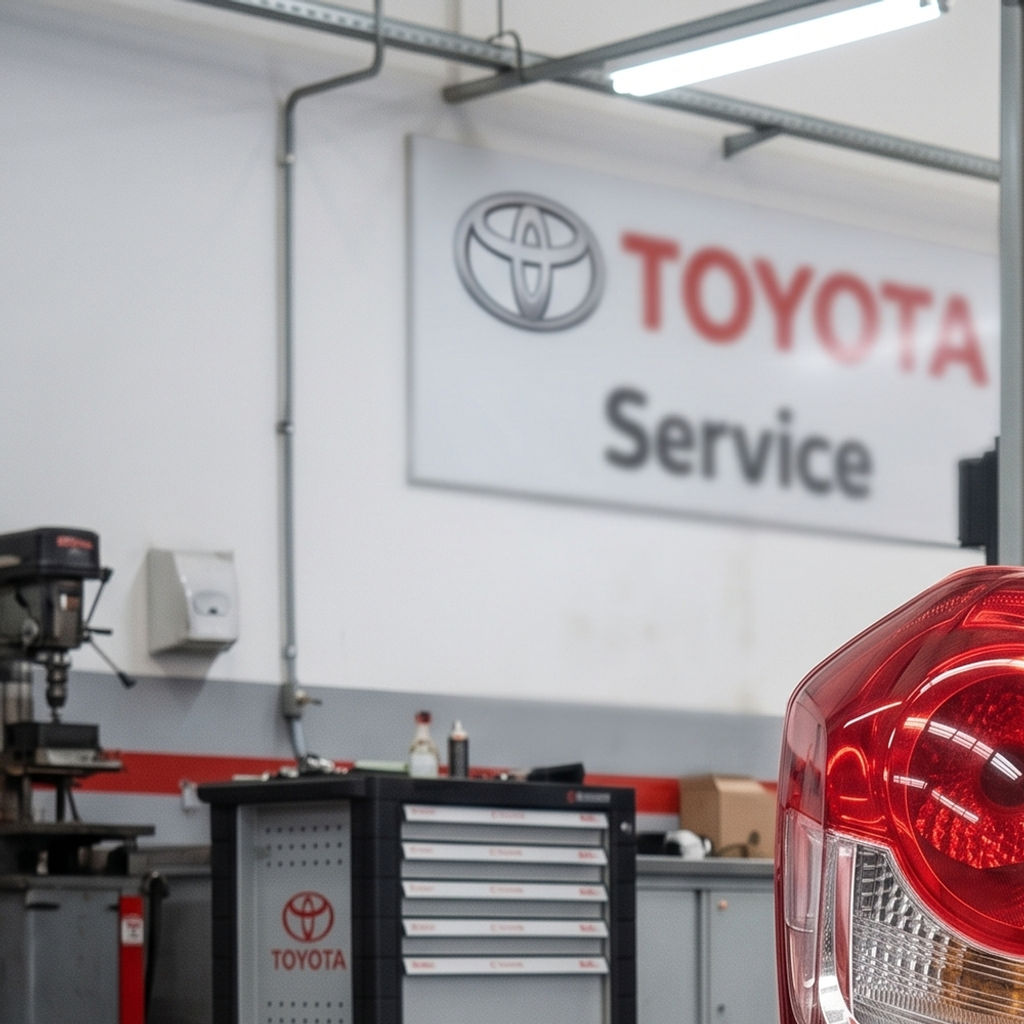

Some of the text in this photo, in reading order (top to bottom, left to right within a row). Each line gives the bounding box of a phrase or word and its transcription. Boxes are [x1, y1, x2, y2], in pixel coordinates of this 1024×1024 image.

[620, 230, 989, 387] TOYOTA
[604, 387, 874, 500] Service
[272, 948, 347, 971] TOYOTA
